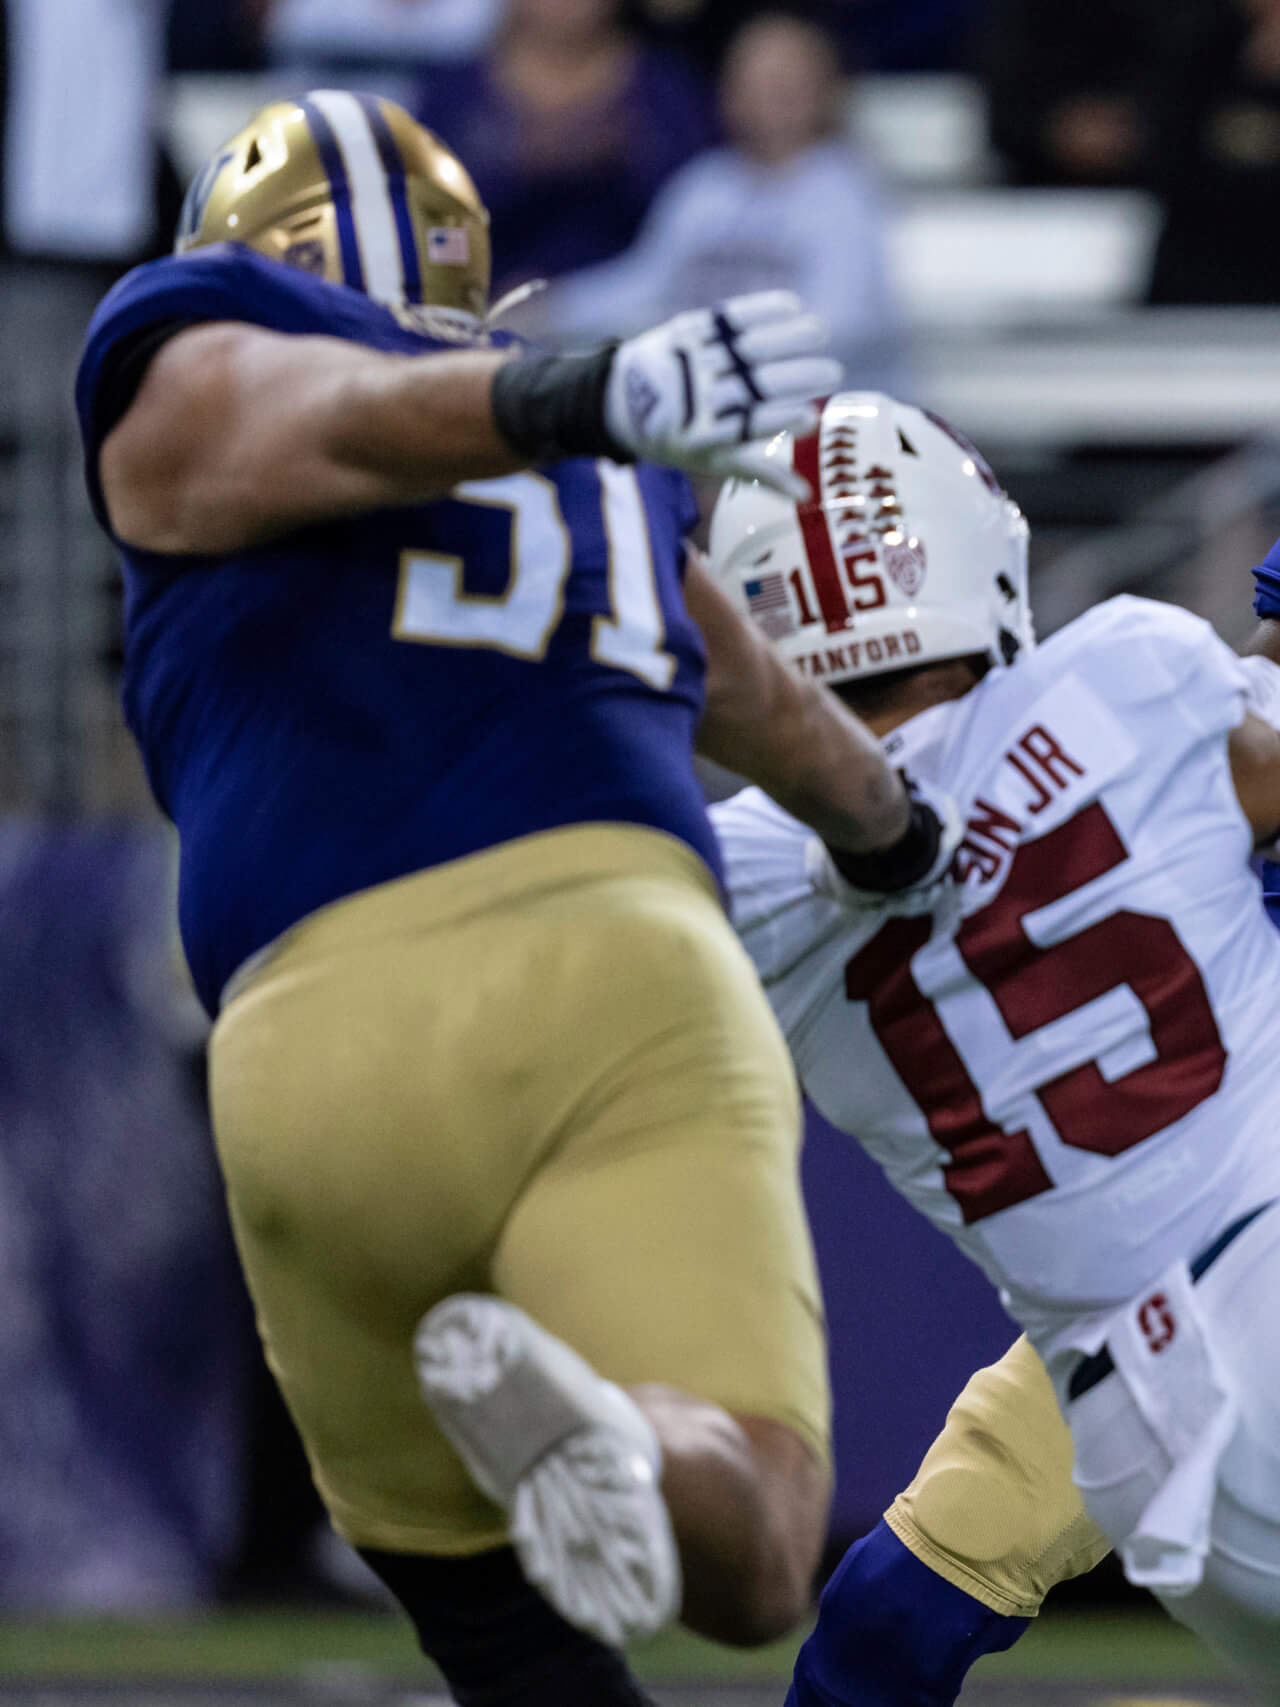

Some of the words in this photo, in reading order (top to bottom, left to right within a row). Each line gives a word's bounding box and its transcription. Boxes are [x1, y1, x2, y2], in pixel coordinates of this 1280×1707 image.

[795, 631, 921, 676] TANFORD
[1005, 724, 1086, 815] JR
[844, 798, 1229, 1226] 15
